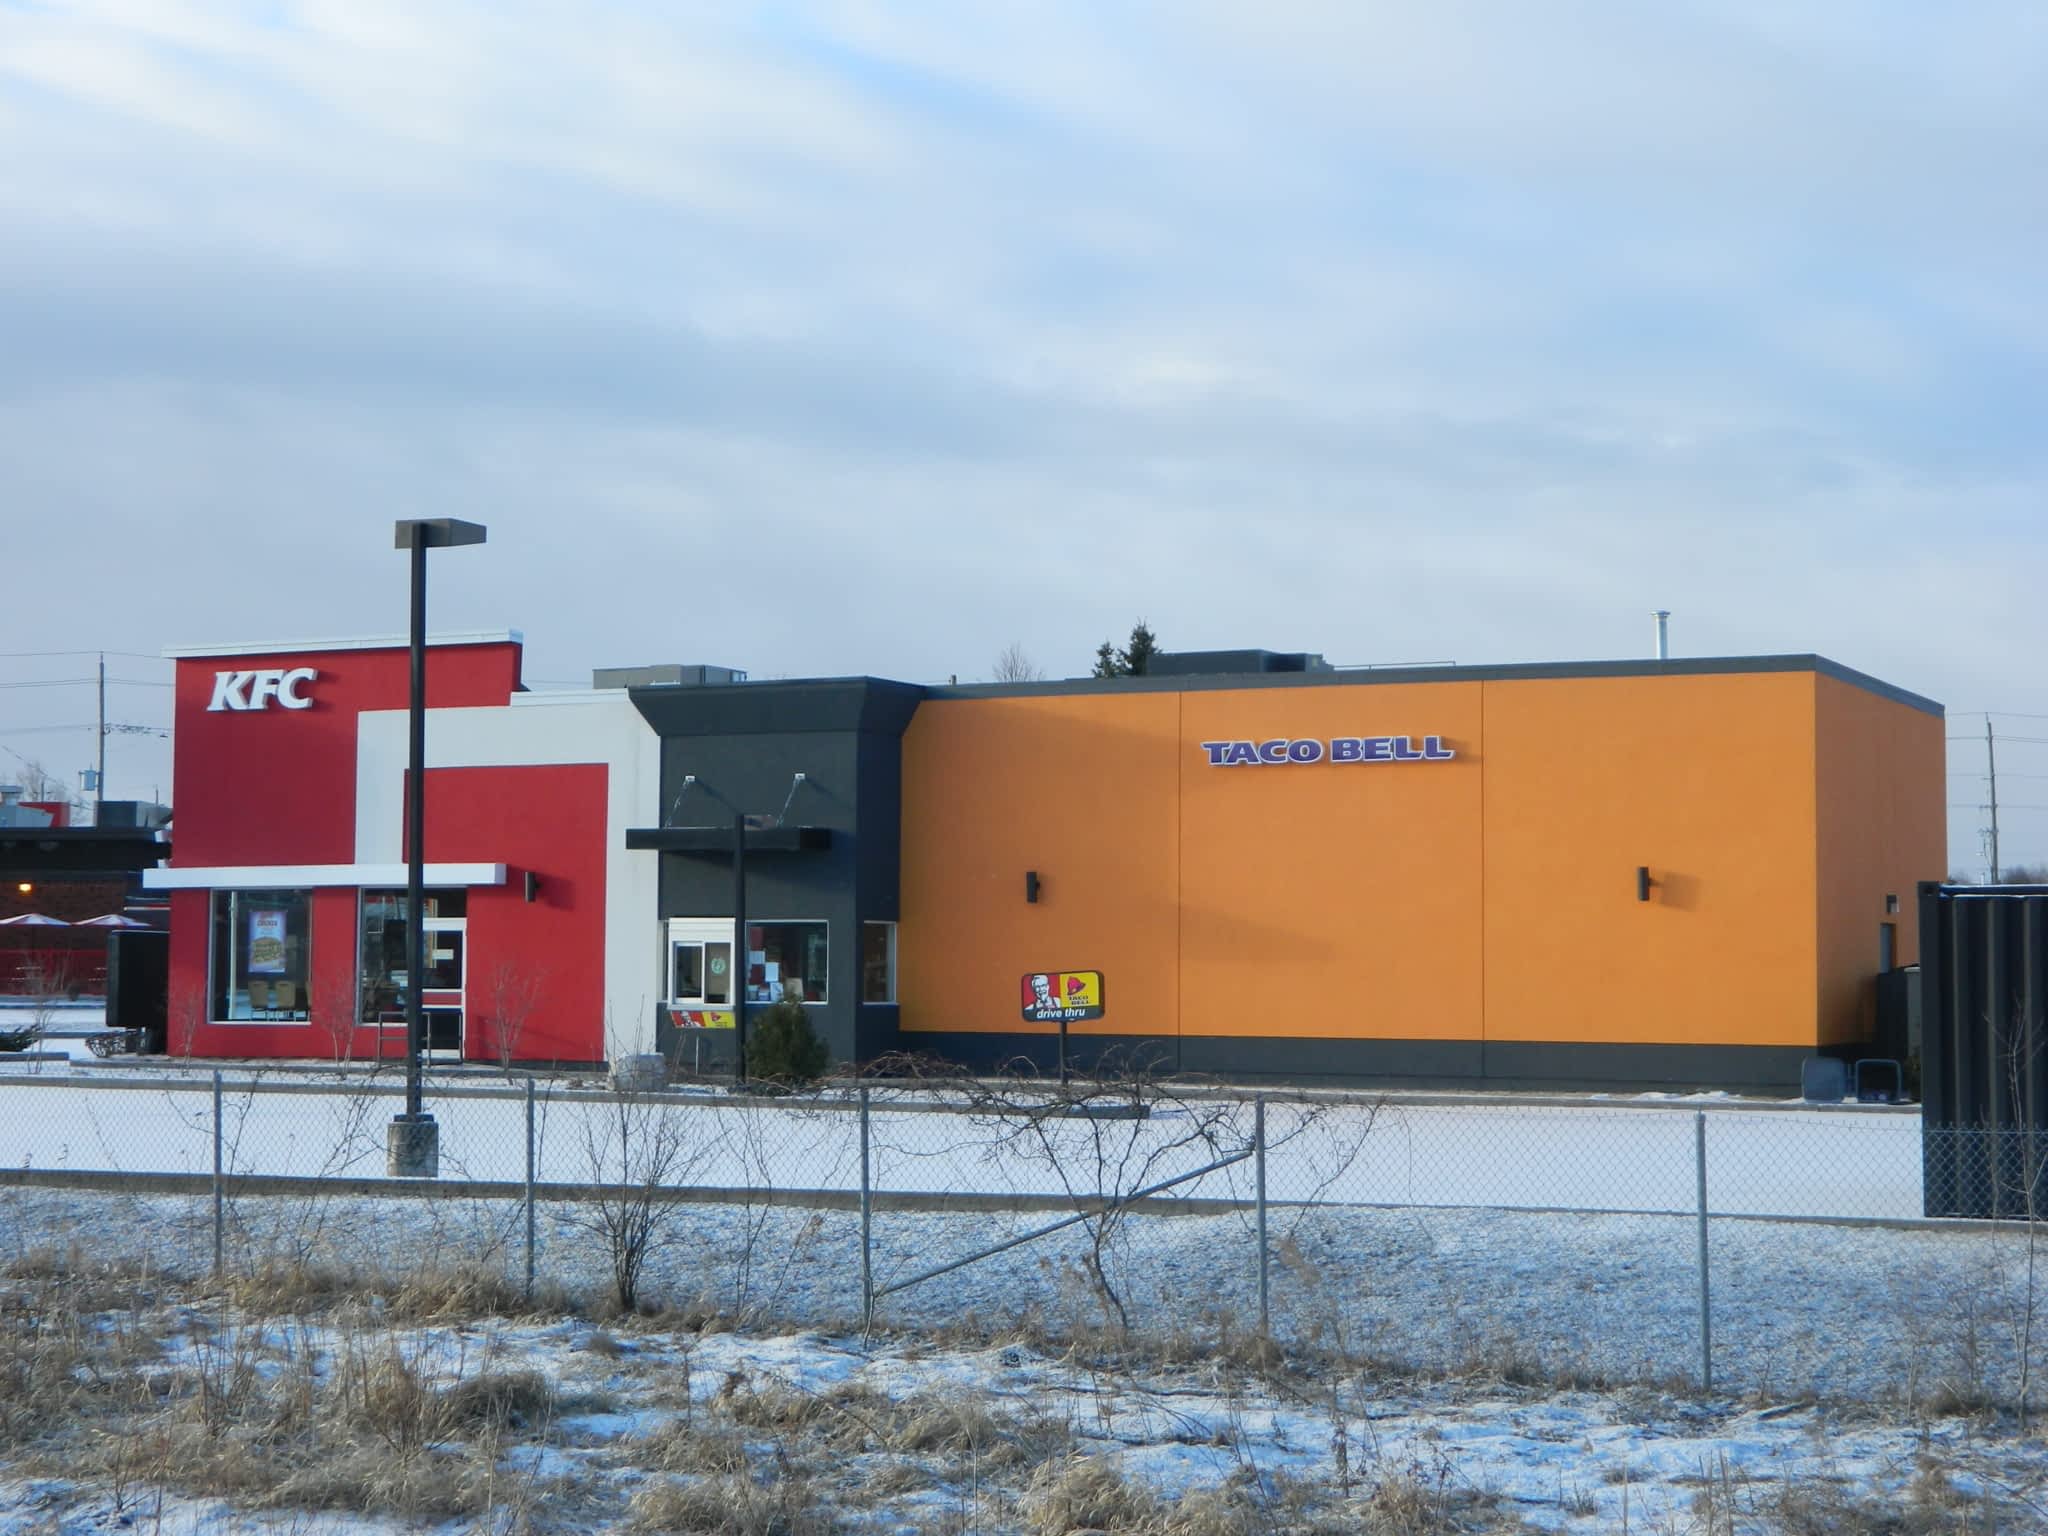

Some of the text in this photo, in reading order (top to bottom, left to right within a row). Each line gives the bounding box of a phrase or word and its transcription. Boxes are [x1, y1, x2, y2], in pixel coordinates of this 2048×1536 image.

[206, 667, 317, 711] KFC
[1200, 736, 1455, 765] TACO BELL
[1036, 1007, 1086, 1019] drive thru
